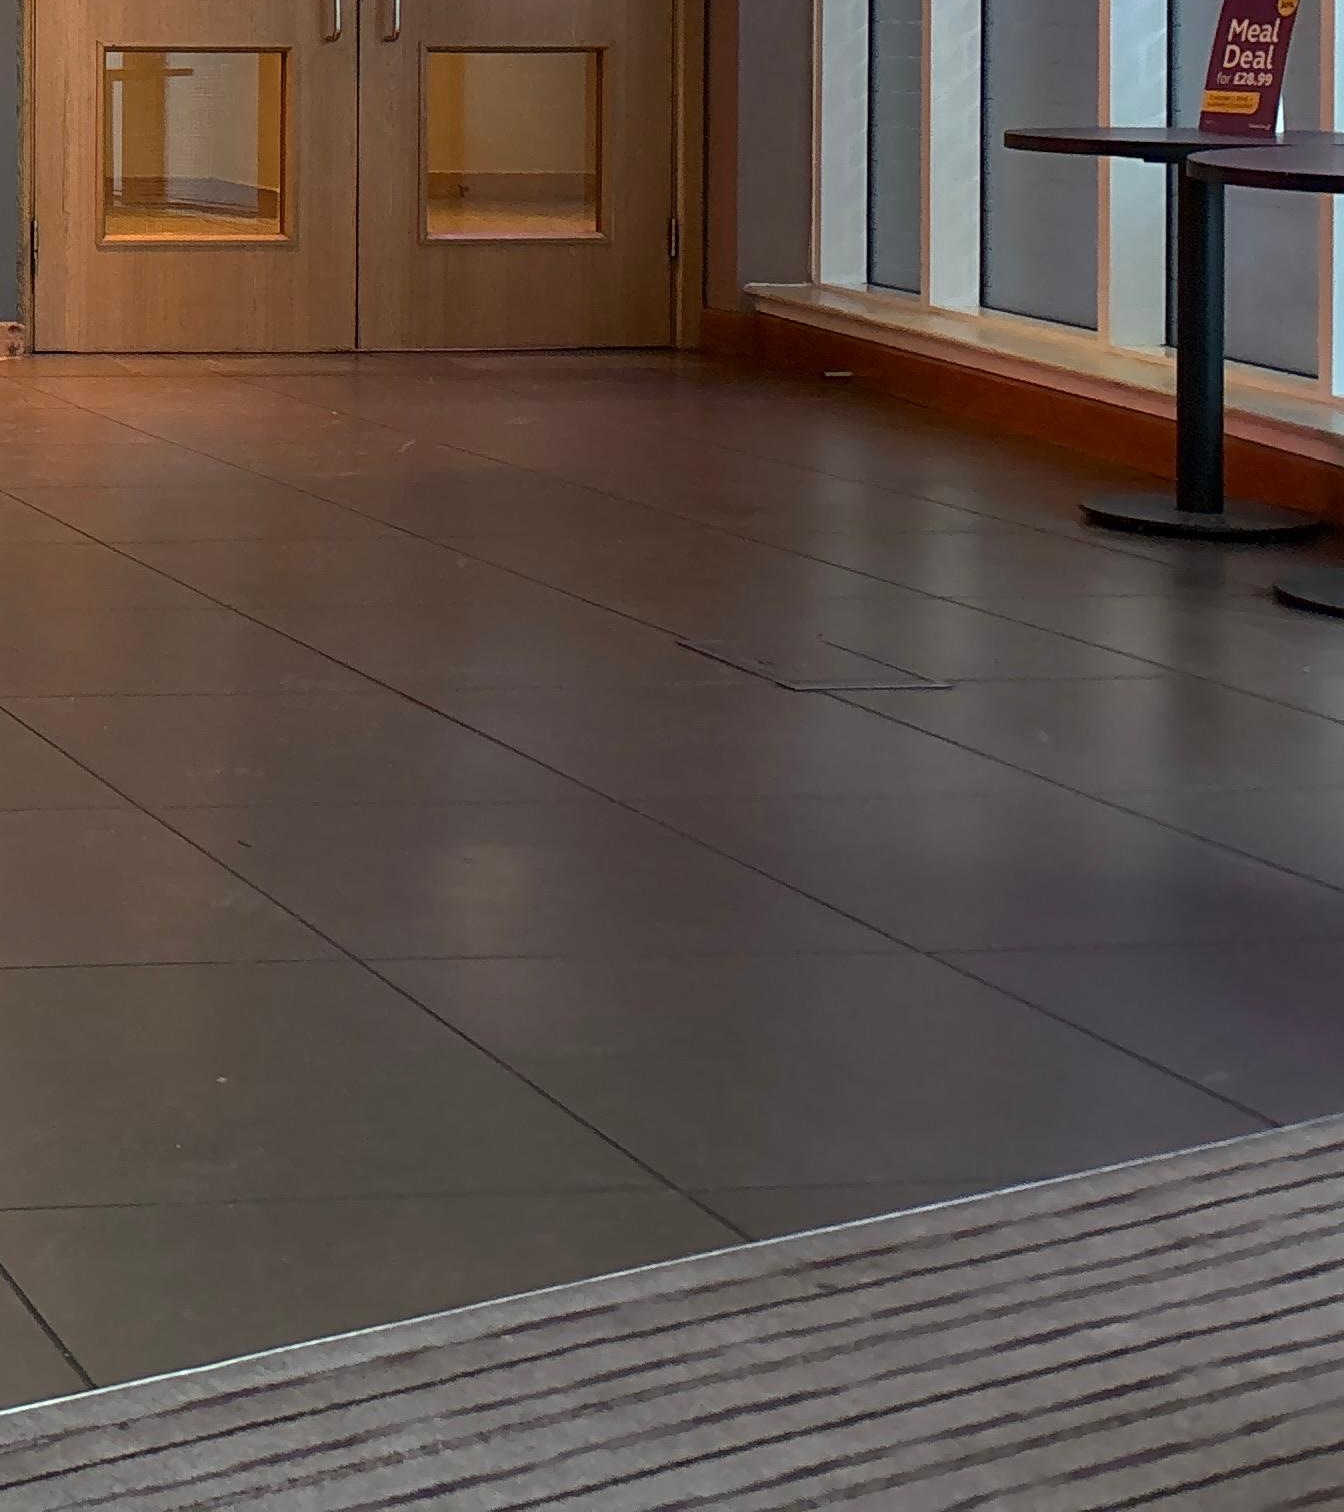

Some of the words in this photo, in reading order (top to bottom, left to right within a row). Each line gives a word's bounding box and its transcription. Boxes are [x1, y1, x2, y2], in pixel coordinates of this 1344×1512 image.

[1227, 17, 1281, 43] Meal
[1222, 44, 1275, 69] Deal
[1216, 71, 1232, 85] for
[1233, 71, 1273, 87] £28.99
